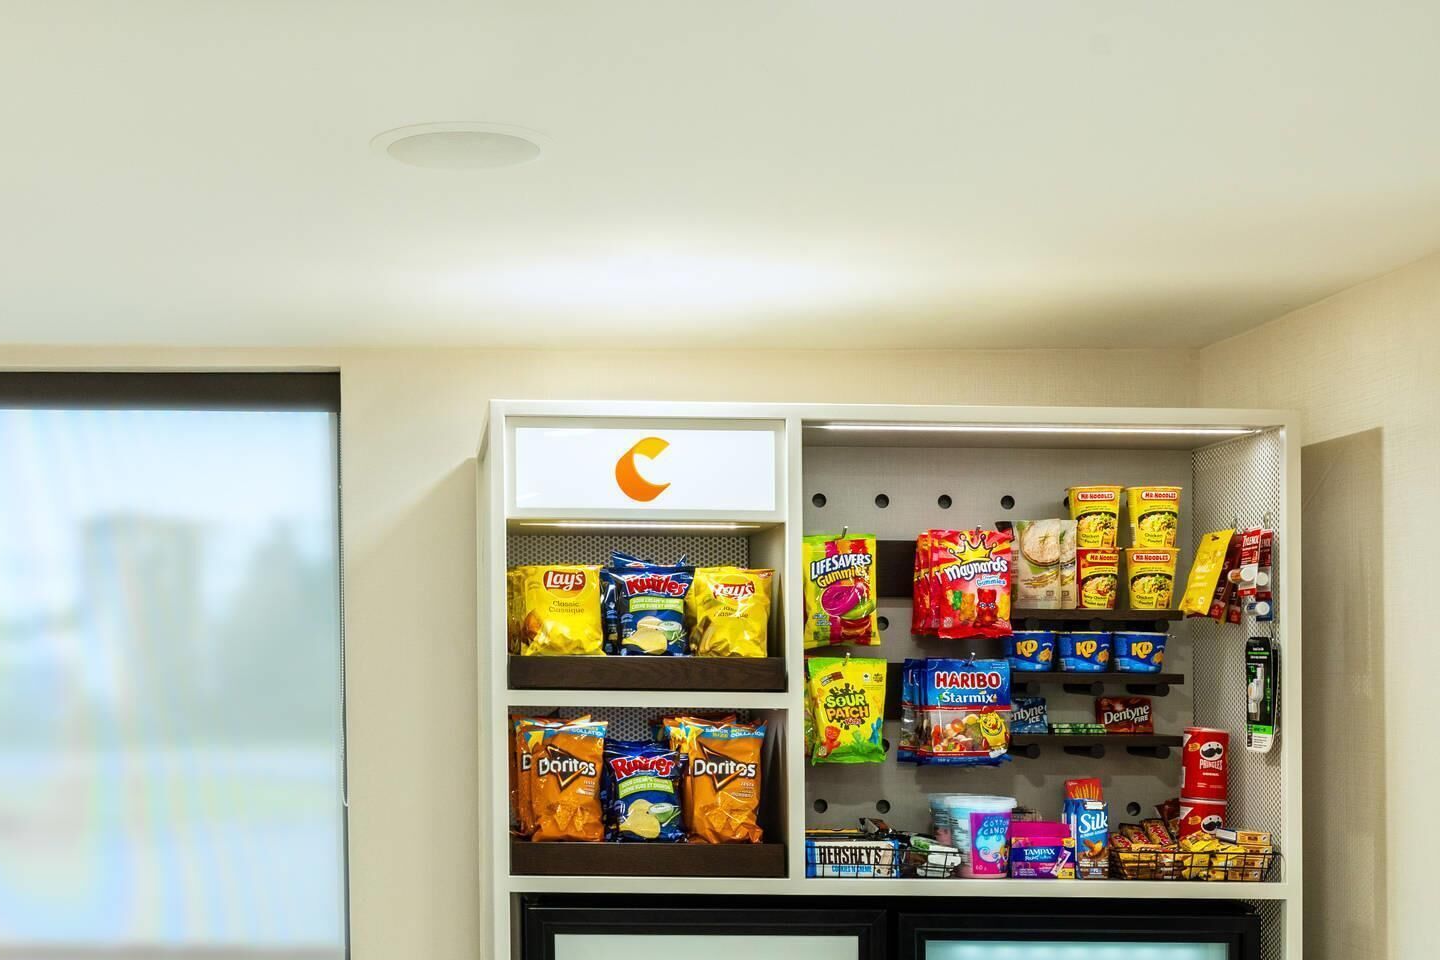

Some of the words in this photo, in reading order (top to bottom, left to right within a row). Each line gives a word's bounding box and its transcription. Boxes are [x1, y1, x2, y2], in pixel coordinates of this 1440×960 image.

[546, 571, 584, 591] Lay's
[935, 672, 1001, 688] HARIBO
[826, 694, 866, 708] SOUR
[942, 690, 994, 704] Starmix
[826, 706, 870, 721] PATCH
[1028, 715, 1040, 724] ICE
[1104, 704, 1150, 725] Dentyne
[1134, 715, 1149, 724] FIRE
[539, 757, 596, 776] Doritos
[694, 760, 756, 777] Doritos
[1199, 759, 1223, 771] PRINGLES
[1078, 811, 1109, 834] Silk
[1024, 848, 1056, 857] TAMPAX
